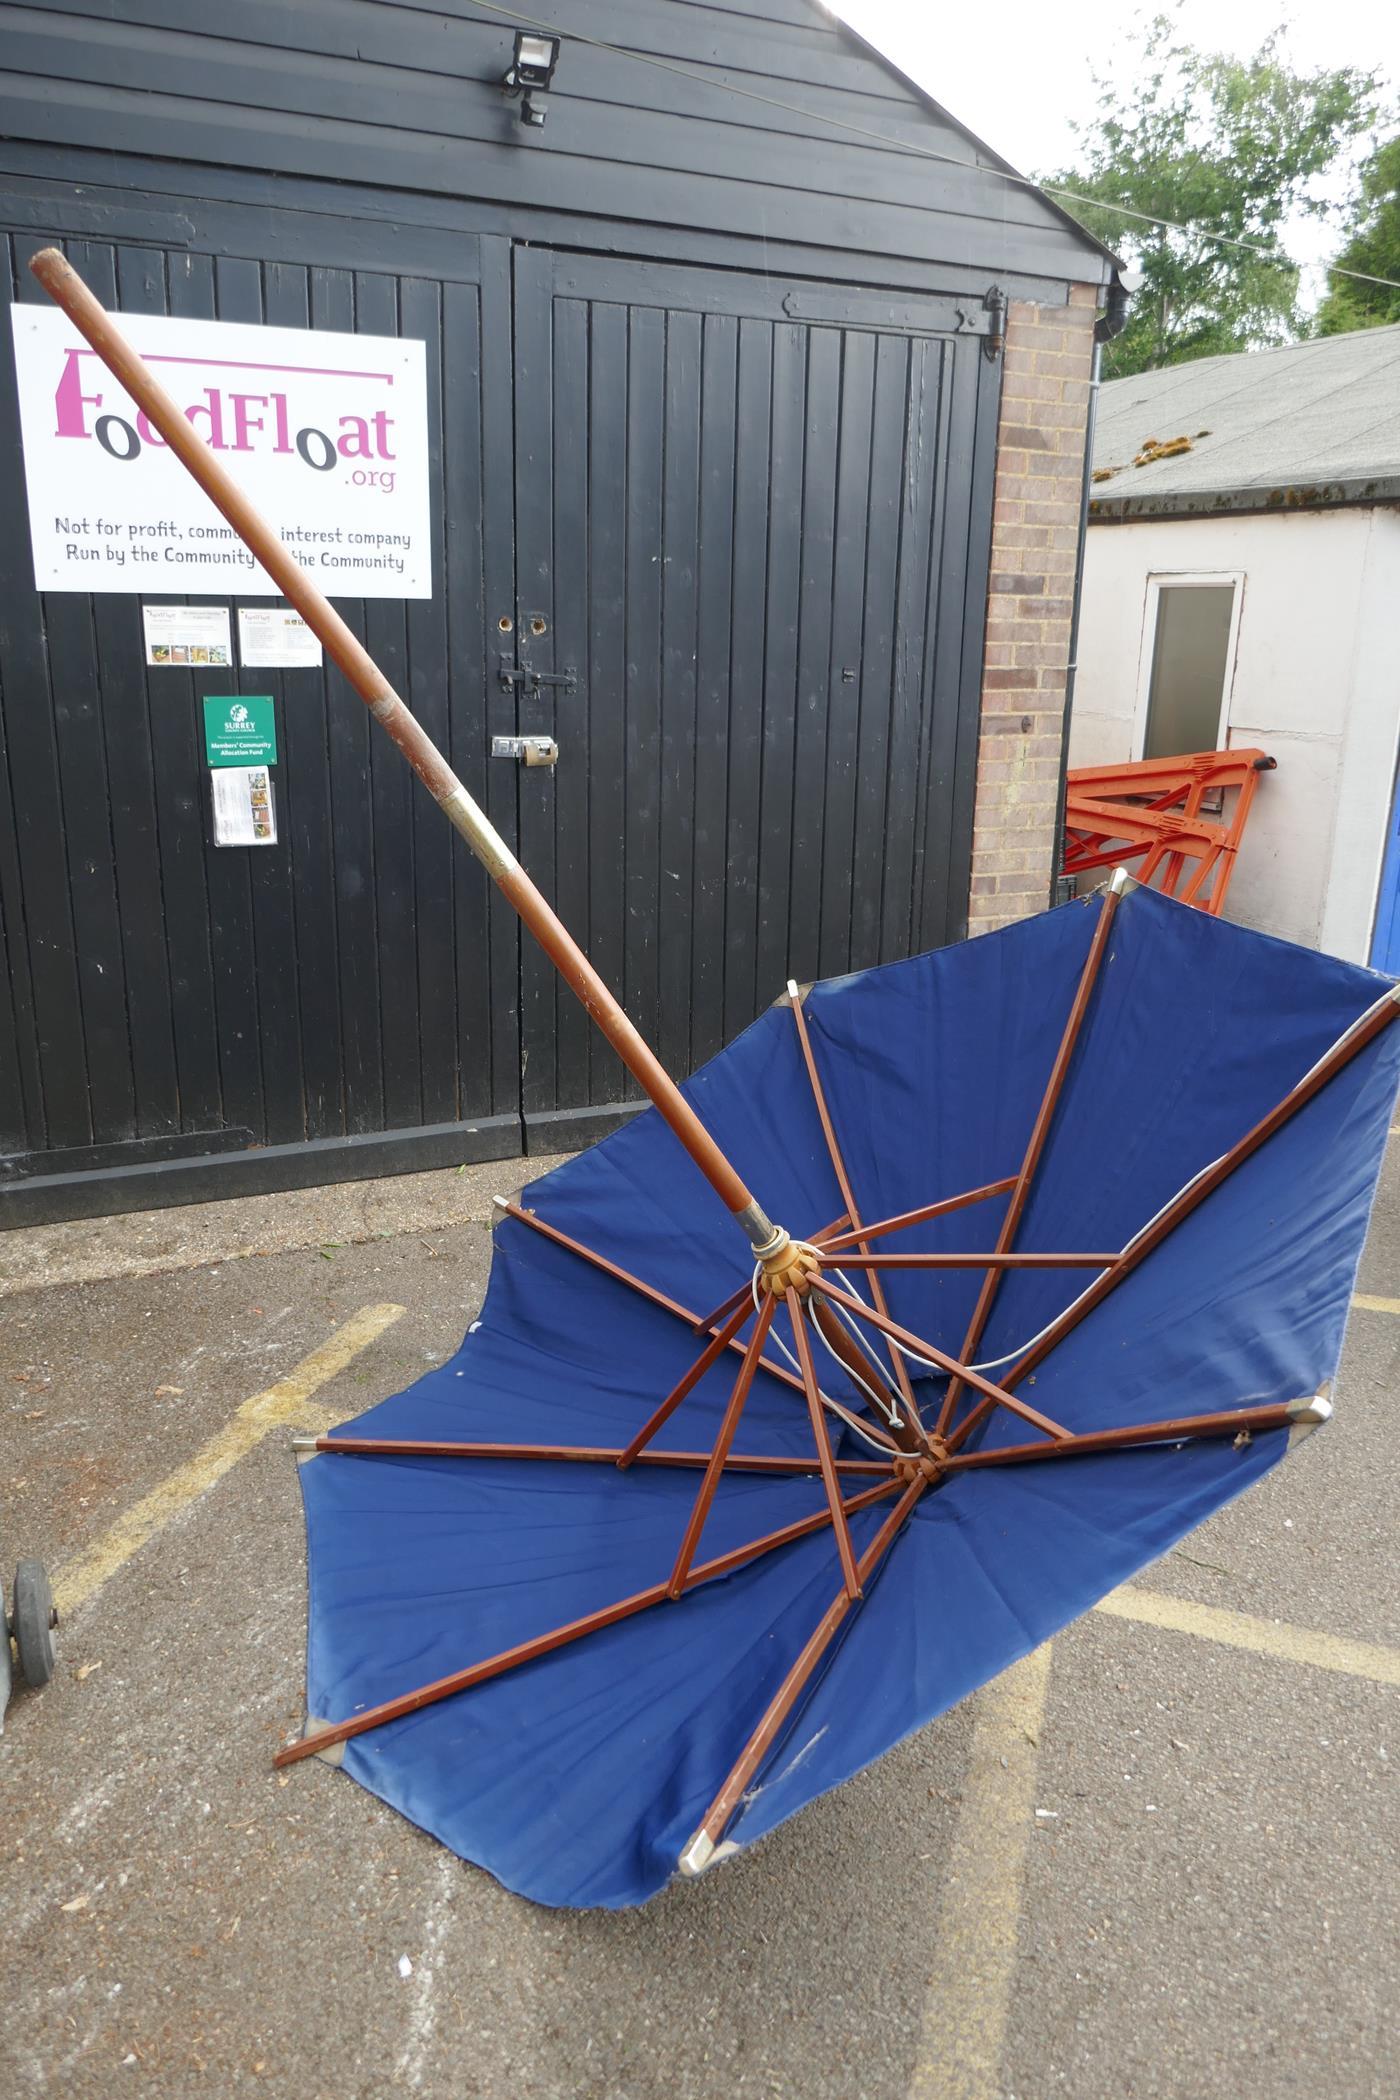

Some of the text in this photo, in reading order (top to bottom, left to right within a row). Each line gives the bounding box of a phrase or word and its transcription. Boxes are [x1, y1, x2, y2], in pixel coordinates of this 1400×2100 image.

[345, 470, 396, 494] .org
[55, 517, 90, 535] Not
[96, 518, 122, 536] for
[128, 520, 183, 541] profit,
[280, 526, 342, 543] interest
[348, 532, 411, 550] company
[66, 543, 101, 561] Run
[106, 545, 125, 566] by
[131, 545, 158, 562] the
[164, 547, 255, 569] Community
[320, 552, 404, 573] Community
